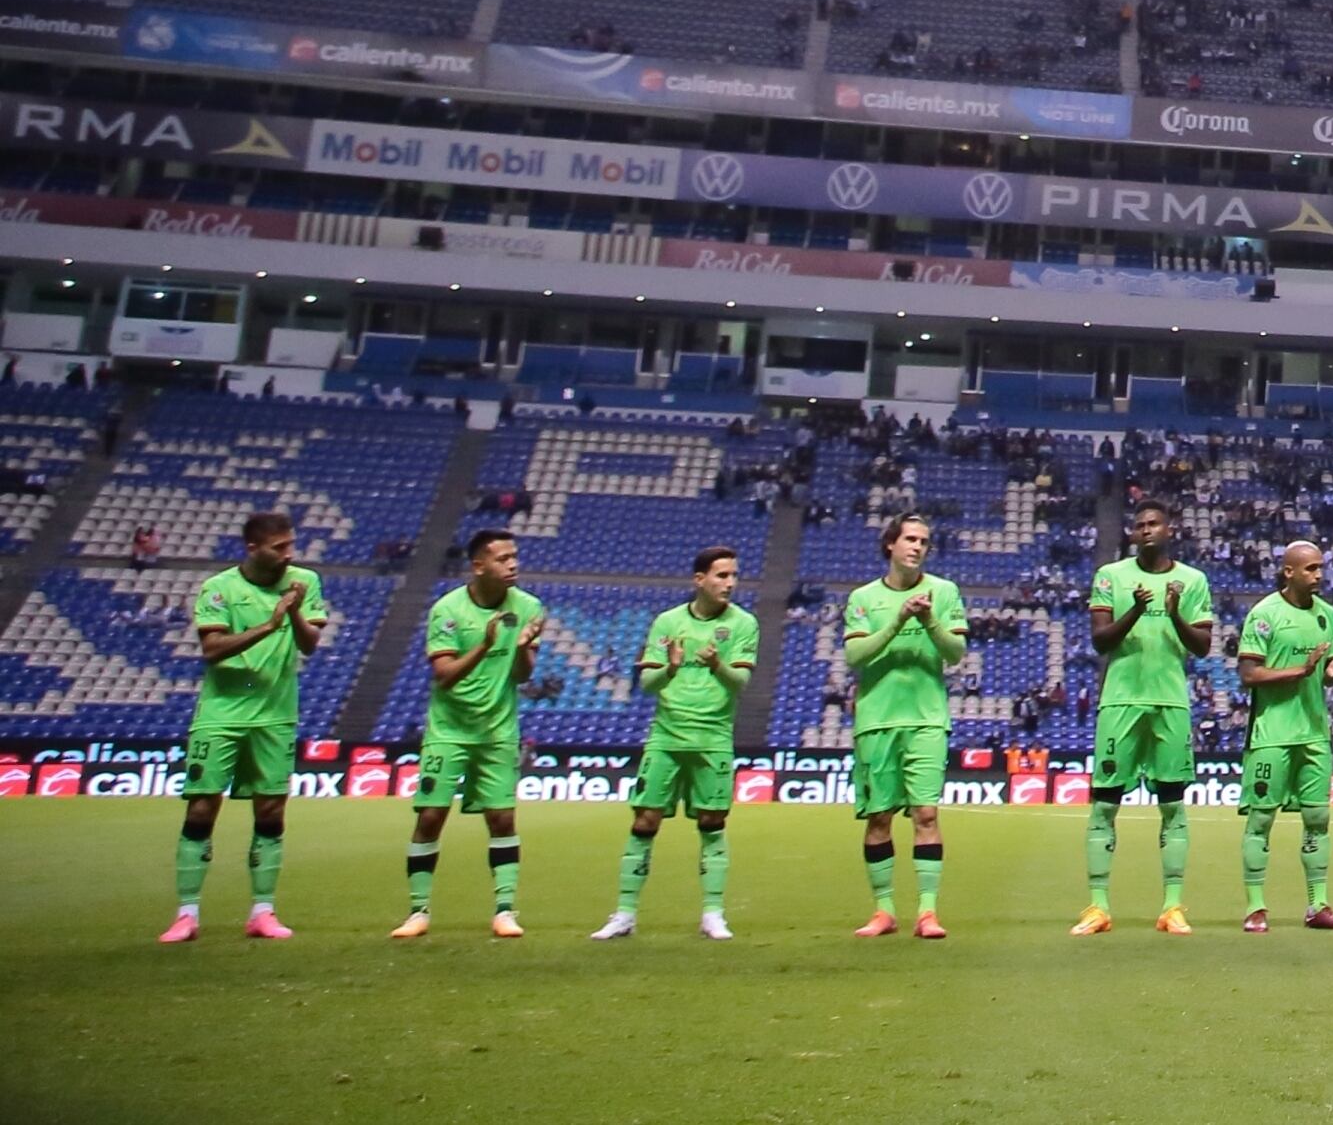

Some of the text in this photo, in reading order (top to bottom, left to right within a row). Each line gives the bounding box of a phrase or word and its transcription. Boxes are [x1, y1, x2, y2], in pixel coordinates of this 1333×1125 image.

[320, 41, 474, 73] caliente.mx
[665, 73, 795, 101] caliente.mx
[862, 87, 1000, 118] caliente.mx
[1160, 105, 1250, 135] Corona
[320, 133, 665, 186] Mobil Mobil Mobil
[1041, 184, 1257, 229] PIRMA
[192, 741, 210, 760] 33
[1106, 738, 1116, 755] 3
[424, 755, 443, 774] 23
[1255, 762, 1271, 780] 28
